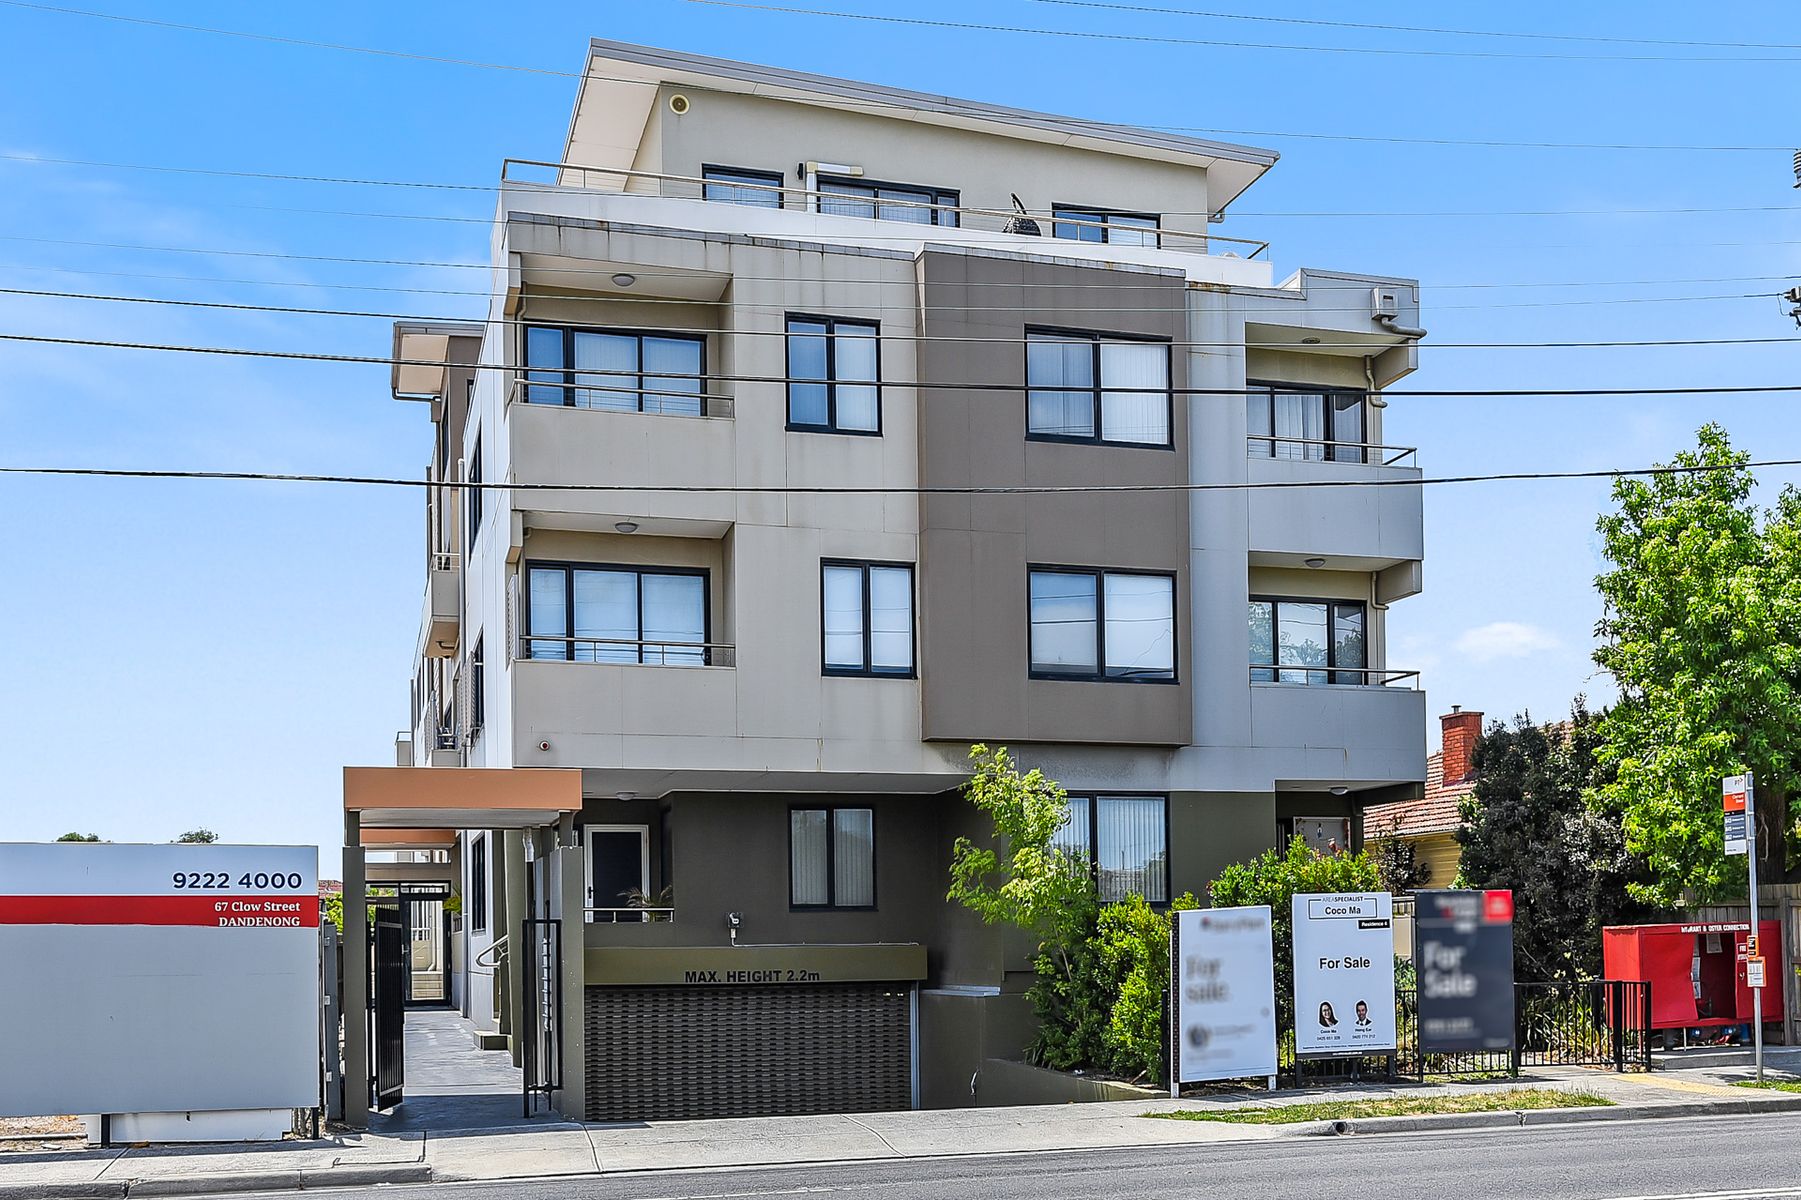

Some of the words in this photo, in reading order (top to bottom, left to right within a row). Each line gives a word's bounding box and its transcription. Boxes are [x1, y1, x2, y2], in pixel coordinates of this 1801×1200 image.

[173, 873, 230, 888] 9222
[238, 873, 302, 888] 4000
[214, 902, 229, 911] 67
[231, 902, 261, 911] Clow
[264, 902, 300, 911] Street
[1325, 906, 1347, 915] Coco
[1349, 906, 1361, 914] Ma
[219, 917, 300, 927] DANDENONG
[1319, 958, 1340, 969] For
[1344, 956, 1370, 968] Sale
[685, 971, 721, 983] MAX.
[726, 971, 781, 983] HEIGHT
[787, 970, 820, 982] 2.2m
